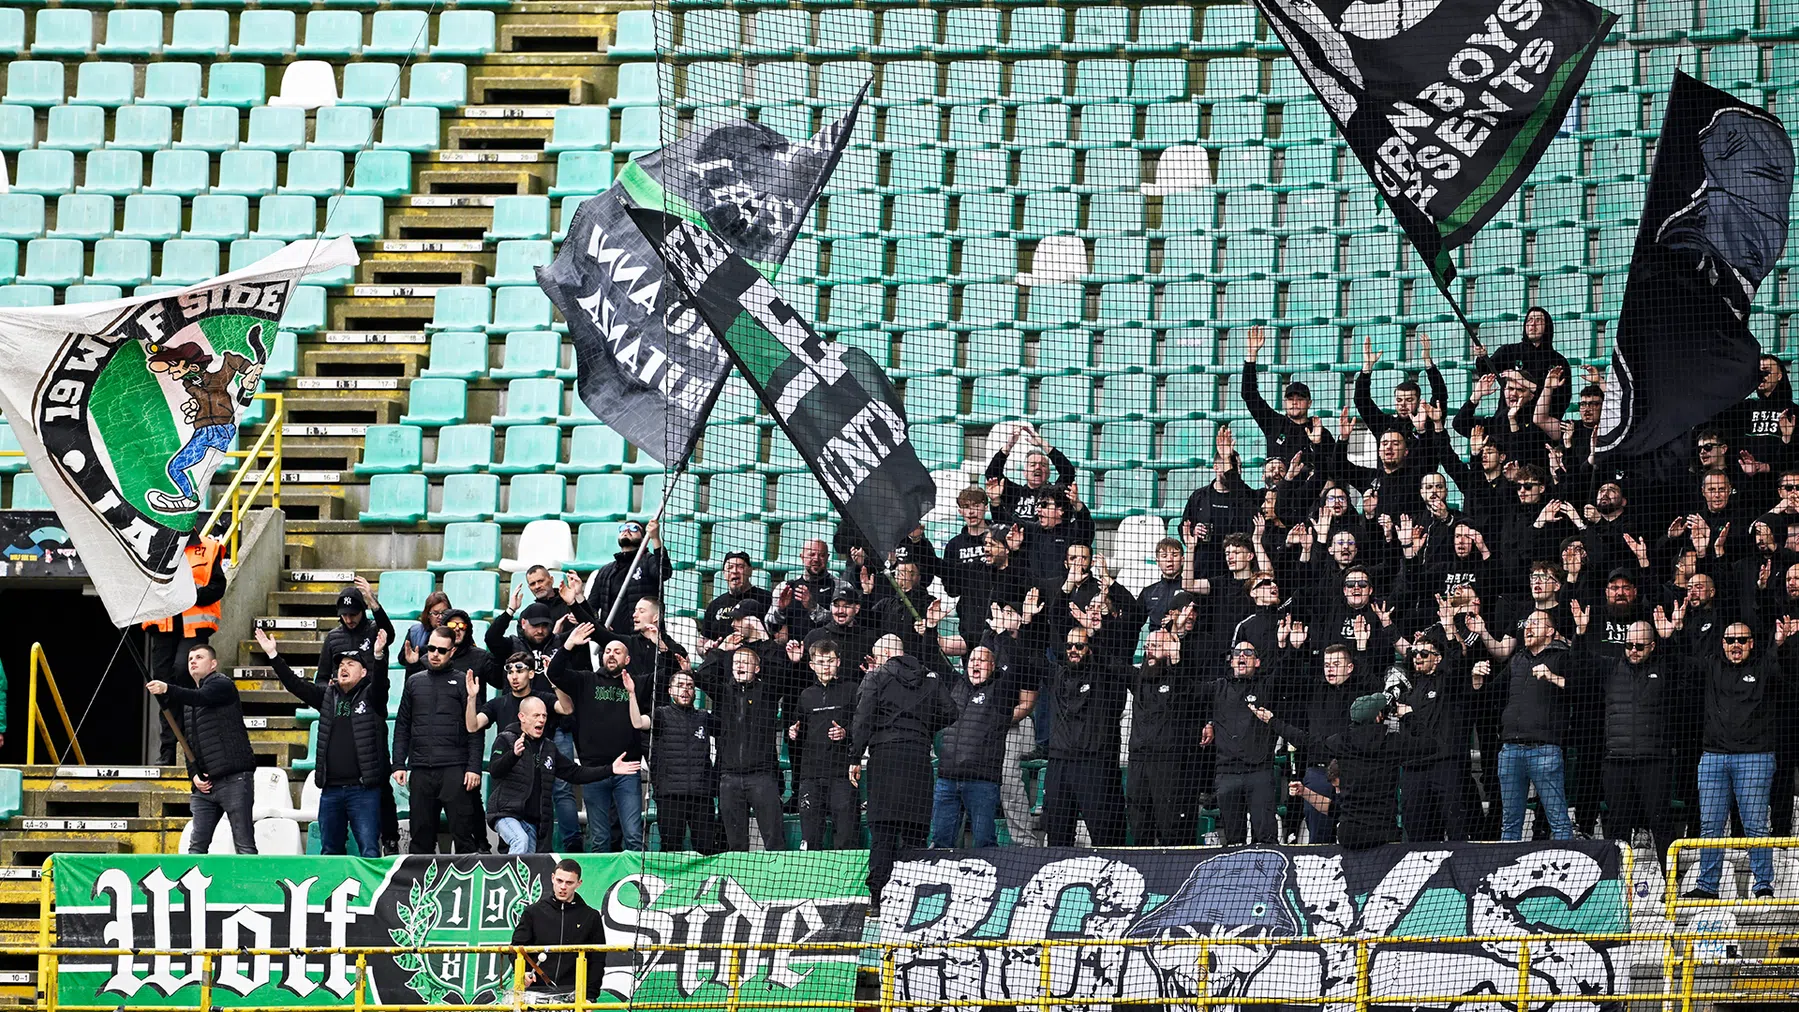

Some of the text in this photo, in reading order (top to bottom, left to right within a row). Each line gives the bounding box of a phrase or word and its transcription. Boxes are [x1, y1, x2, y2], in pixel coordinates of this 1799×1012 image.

[1416, 0, 1544, 112] BOYS
[178, 281, 288, 319] SIDE
[45, 378, 85, 424] 19
[194, 546, 207, 557] 27
[266, 620, 275, 628] 10
[300, 620, 316, 628] 13-1
[250, 719, 266, 727] 12-1
[24, 821, 49, 829] 44-29
[109, 821, 127, 829] 12-1
[446, 885, 504, 926] 19
[92, 865, 362, 999] Wolf
[601, 873, 826, 999] Side
[12, 974, 28, 982] 10-1
